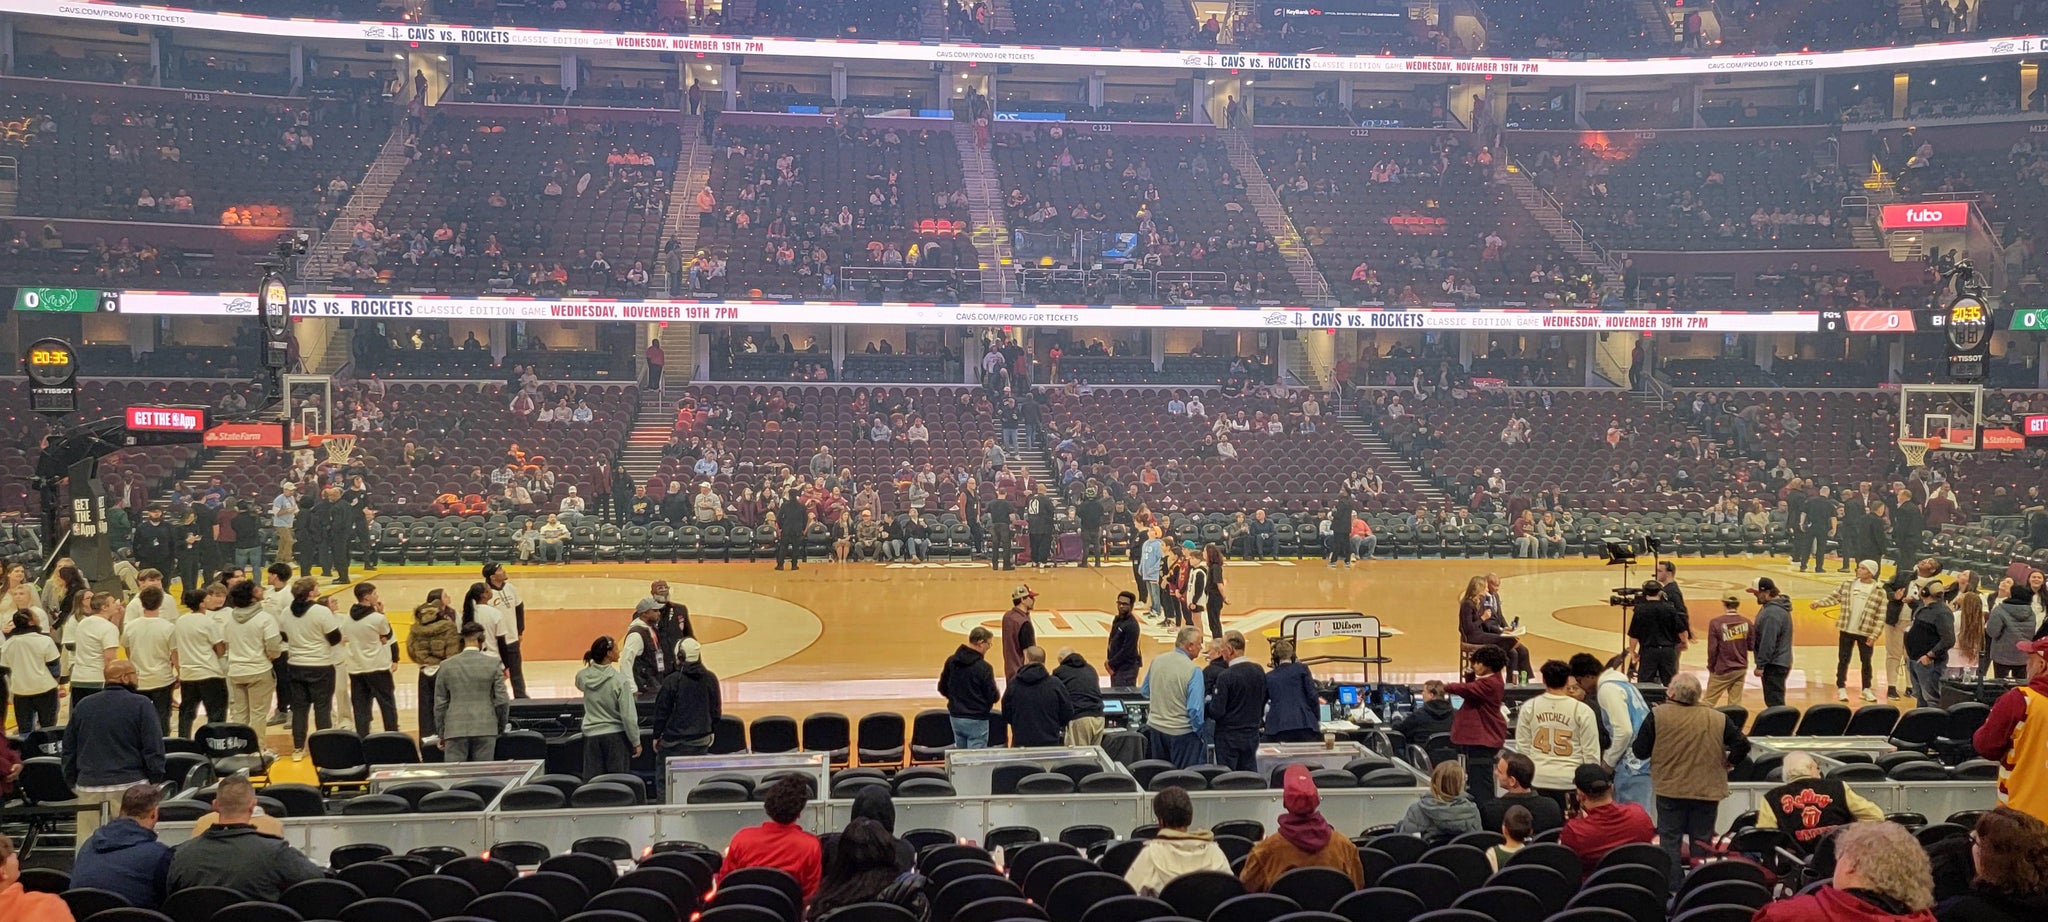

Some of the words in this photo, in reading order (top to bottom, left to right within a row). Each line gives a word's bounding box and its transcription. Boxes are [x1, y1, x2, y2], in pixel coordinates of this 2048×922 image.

[59, 6, 132, 19] CAVS.COM/PROMO
[151, 15, 185, 23] TICKETS
[408, 28, 435, 40] CAVS
[462, 30, 509, 43] ROCKETS
[512, 35, 548, 43] CLASSIC
[553, 36, 588, 45] EDITION
[593, 37, 613, 46] GAME
[672, 39, 718, 50] NOVEMBER
[722, 41, 741, 51] 19TH
[745, 42, 764, 52] 7PM
[936, 51, 993, 59] CAVS.COM/PROMO
[1221, 56, 1245, 68] CAVS
[1268, 57, 1311, 69] ROCKETS
[1313, 61, 1345, 69] CLASSIC
[1349, 61, 1381, 70] EDITION
[1385, 61, 1403, 70] GAME
[1456, 62, 1498, 72] NOVEMBER
[1500, 63, 1518, 72] 19TH
[1521, 63, 1539, 73] 7PM
[1907, 208, 1943, 223] fubo
[24, 292, 39, 308] 0
[105, 300, 116, 311] 0
[291, 299, 317, 315] AVS
[351, 300, 413, 316] ROCKETS
[416, 305, 463, 315] CLASSIC
[469, 306, 515, 316] EDITION
[521, 307, 547, 316] GAME
[623, 306, 681, 319] NOVEMBER
[685, 307, 710, 319] 19TH
[715, 307, 738, 319] 7PM
[1823, 311, 1841, 319] FG%
[956, 313, 1028, 321] CAVS.COM/PROMO
[1029, 313, 1045, 321] FOR
[1046, 314, 1079, 322] TICKETS
[1312, 313, 1342, 327] CAVS
[1371, 313, 1424, 327] ROCKETS
[1426, 317, 1467, 326] CLASSIC
[1472, 317, 1512, 326] EDITION
[1517, 317, 1539, 327] GAME
[1605, 316, 1657, 328] NOVEMBER
[1661, 317, 1683, 328] 19TH
[1686, 317, 1708, 328] 7PM
[1887, 314, 1899, 328] 0
[2024, 313, 2036, 327] 0
[1827, 321, 1835, 331] 0
[32, 350, 69, 365] 20:35
[134, 411, 152, 425] GET
[153, 412, 171, 426] THE
[180, 413, 196, 429] App
[2030, 419, 2044, 432] GET
[74, 498, 90, 511] GET
[75, 510, 92, 522] THE
[80, 523, 96, 537] App
[1332, 620, 1362, 630] Wilson
[1536, 711, 1570, 727] MITCHELL
[1533, 725, 1574, 757] 45
